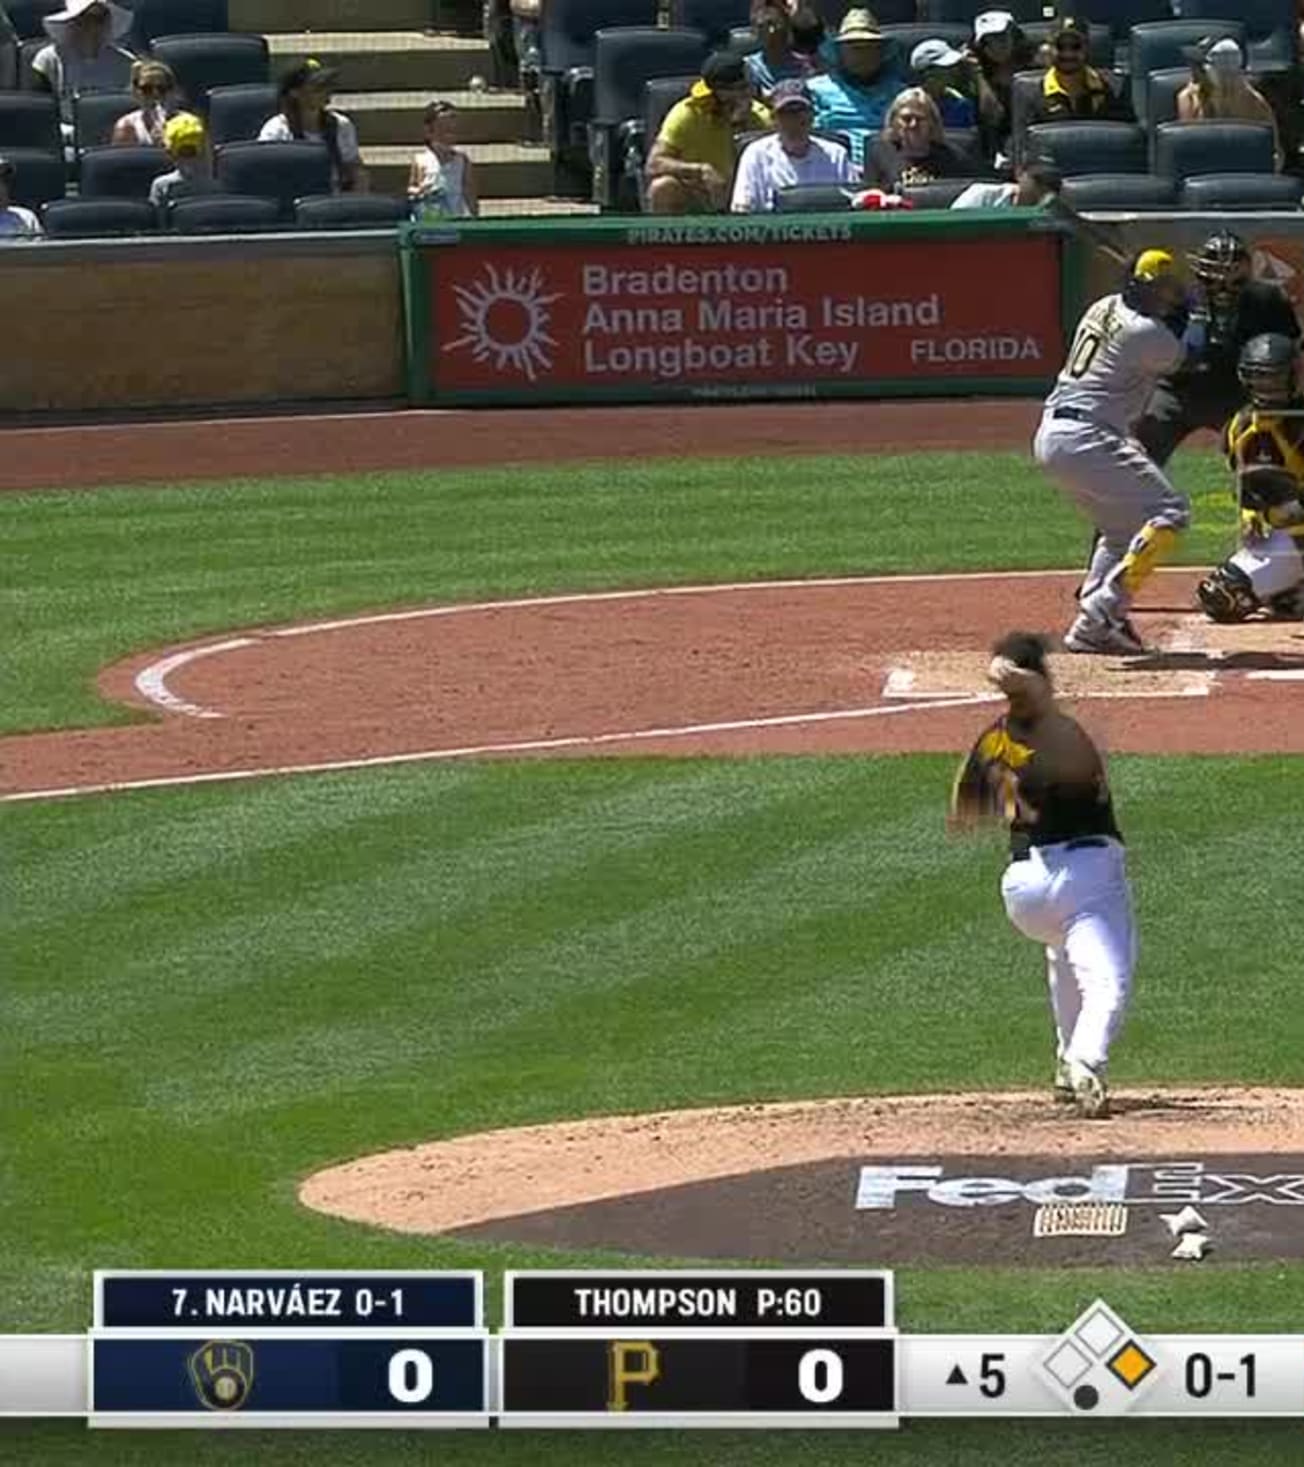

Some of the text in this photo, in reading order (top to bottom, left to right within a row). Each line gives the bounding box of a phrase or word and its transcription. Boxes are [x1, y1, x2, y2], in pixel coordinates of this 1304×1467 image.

[582, 264, 788, 296] Bradenton
[583, 294, 940, 334] Anna Maria Island
[584, 333, 858, 376] Longboat Key
[911, 336, 1041, 363] FLORIDA
